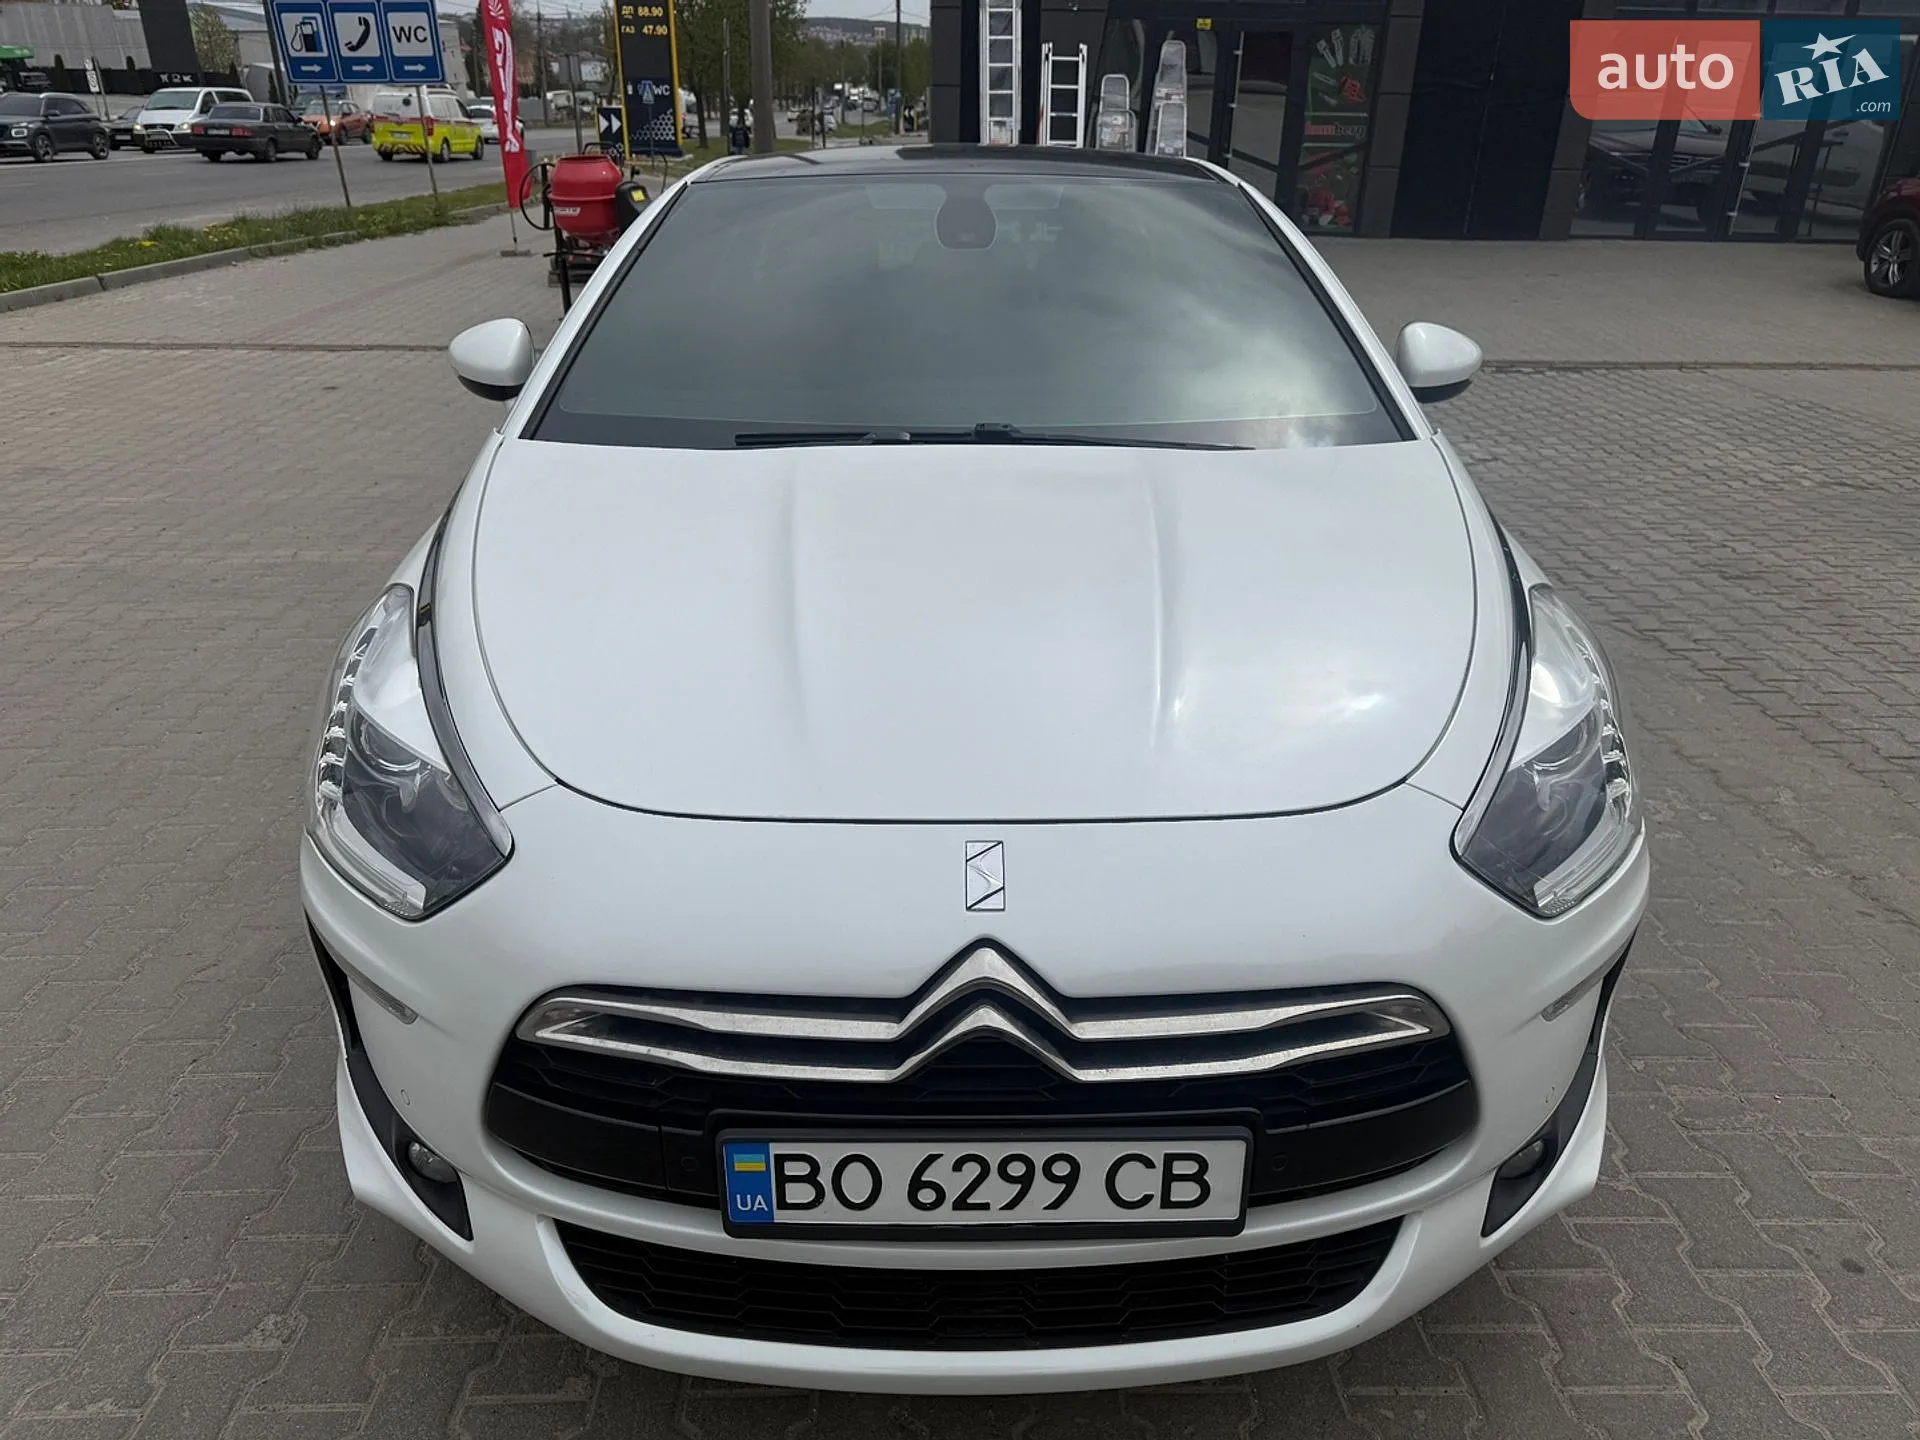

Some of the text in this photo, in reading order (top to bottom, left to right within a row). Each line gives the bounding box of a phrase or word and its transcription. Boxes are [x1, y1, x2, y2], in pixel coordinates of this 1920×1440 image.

[392, 25, 428, 44] WC
[621, 24, 668, 36] ГАЗ 47.90
[652, 84, 671, 96] WC
[773, 1151, 1213, 1212] BO 6299 CB
[736, 1194, 769, 1212] UA
